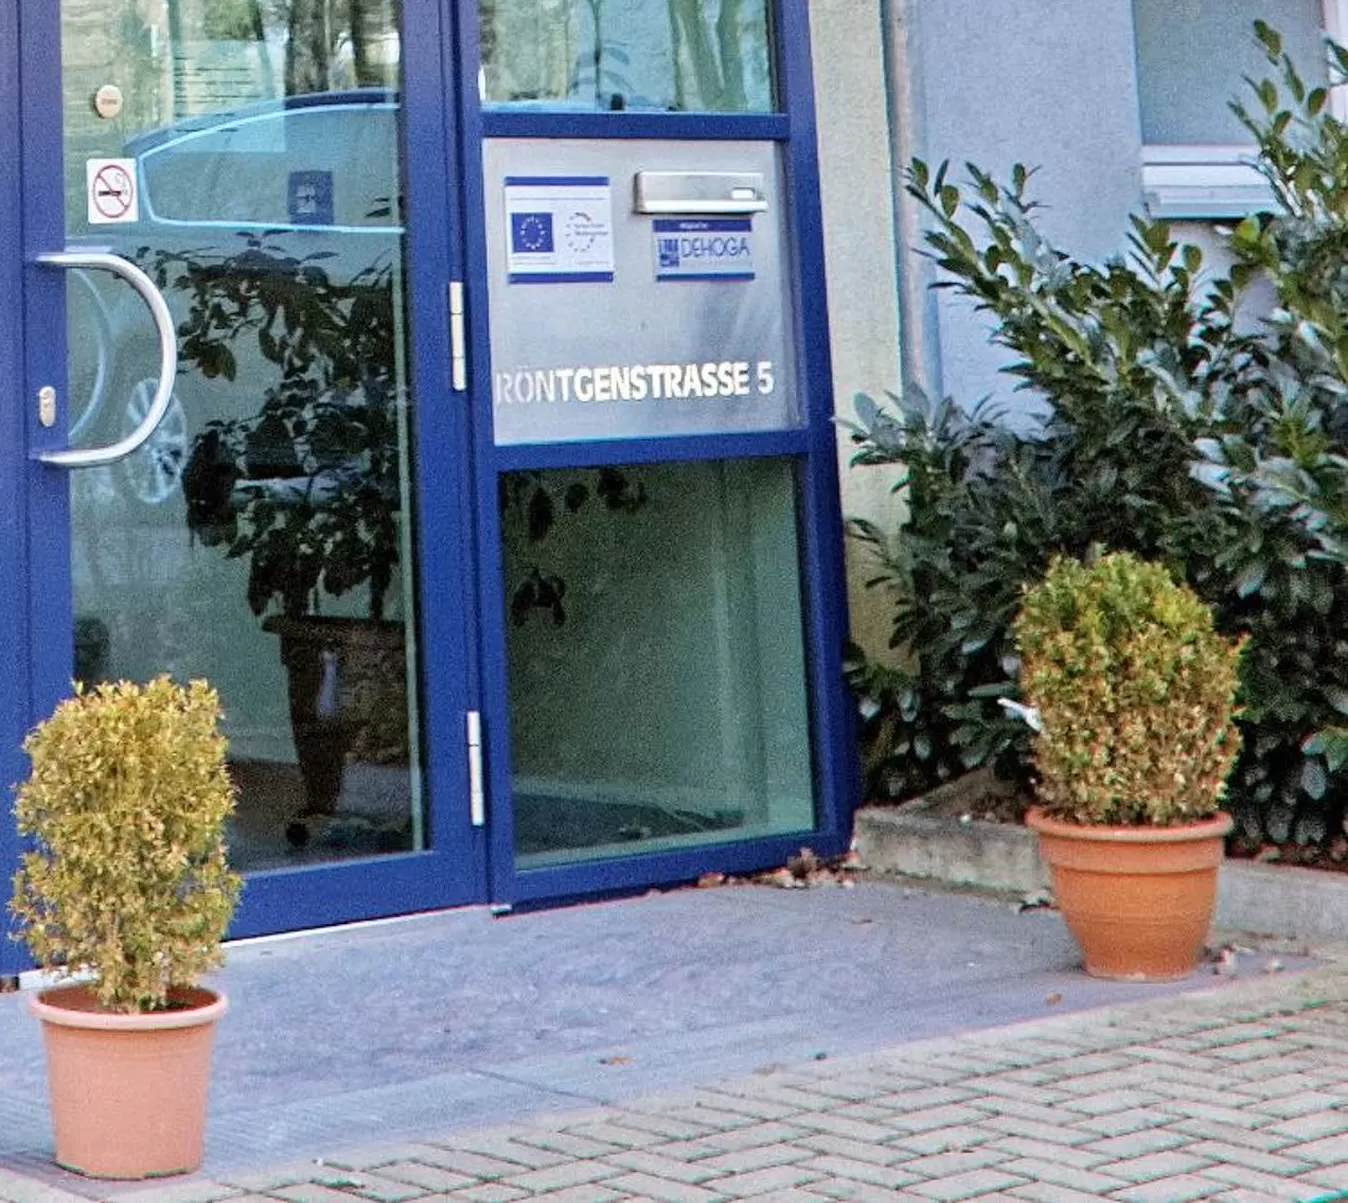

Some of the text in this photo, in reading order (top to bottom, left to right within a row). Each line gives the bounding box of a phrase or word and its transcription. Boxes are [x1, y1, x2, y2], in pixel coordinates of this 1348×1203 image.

[681, 237, 750, 257] DEHOGA
[496, 361, 774, 404] RÖNTGENSTRASSE 5
